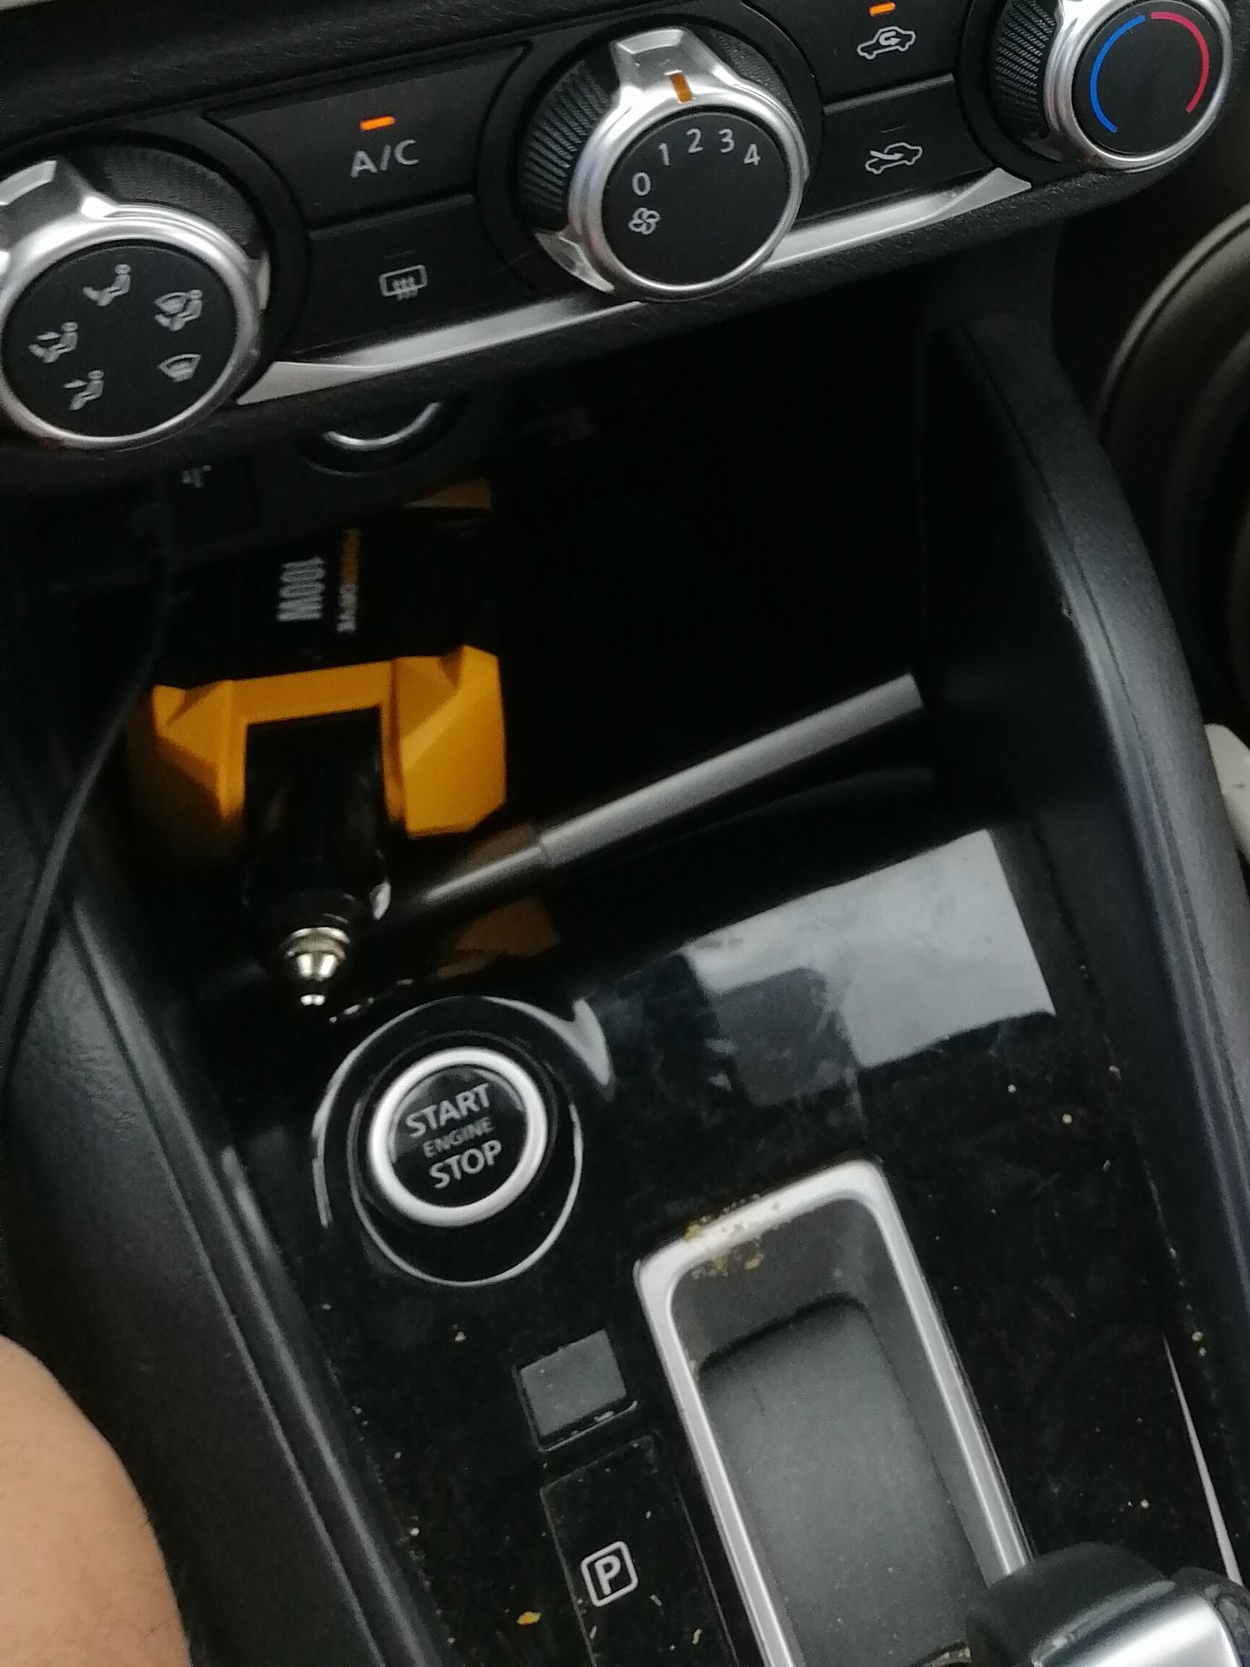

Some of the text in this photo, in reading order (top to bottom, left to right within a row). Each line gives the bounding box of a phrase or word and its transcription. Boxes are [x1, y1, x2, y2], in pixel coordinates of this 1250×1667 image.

[657, 142, 672, 166] 1
[685, 128, 704, 154] 2
[718, 128, 736, 154] 3
[743, 143, 762, 167] 4
[349, 139, 420, 178] A/C
[631, 172, 652, 197] 0
[405, 1082, 490, 1139] START
[422, 1115, 494, 1159] ENGINE
[429, 1139, 502, 1190] STOP
[594, 1555, 621, 1596] P
